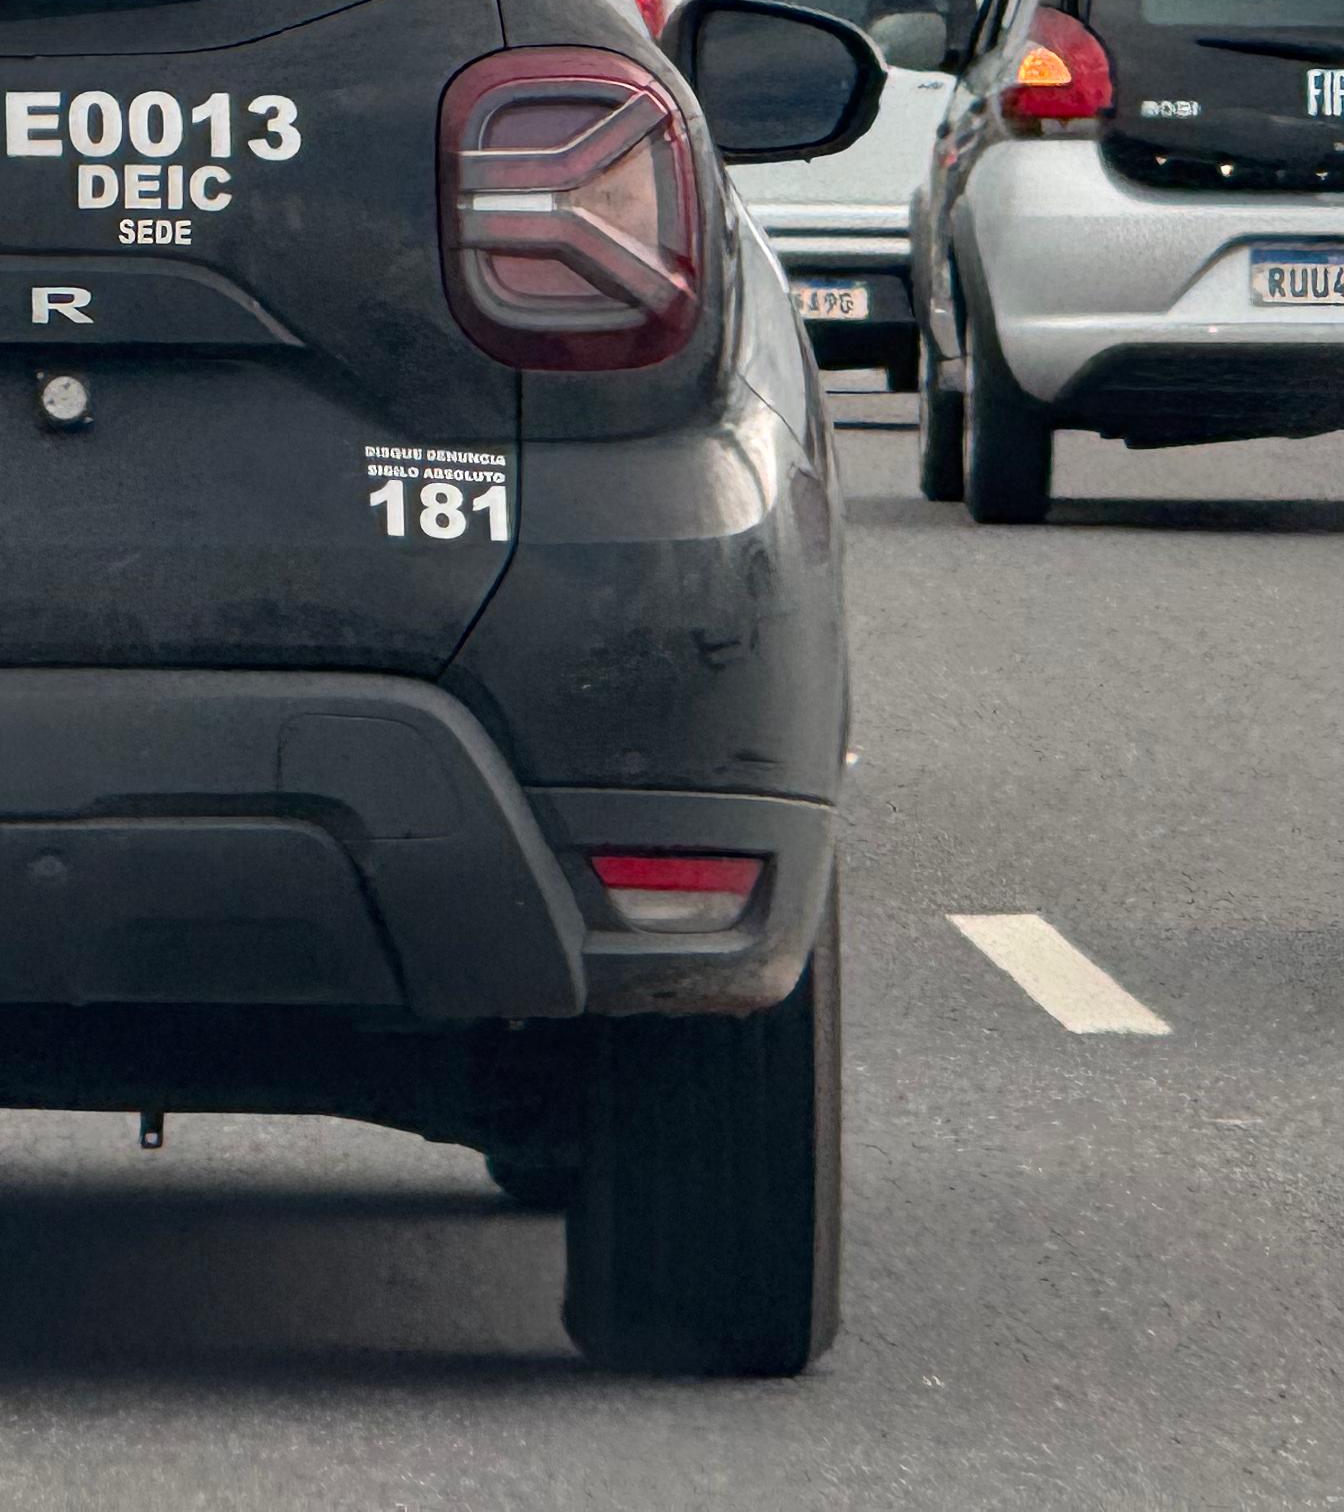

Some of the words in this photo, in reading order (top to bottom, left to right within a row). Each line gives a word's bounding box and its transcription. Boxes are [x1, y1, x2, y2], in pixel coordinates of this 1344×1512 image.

[5, 90, 302, 162] E0013
[77, 164, 233, 212] DEIC
[118, 218, 192, 245] SEDE
[369, 479, 510, 542] 181
